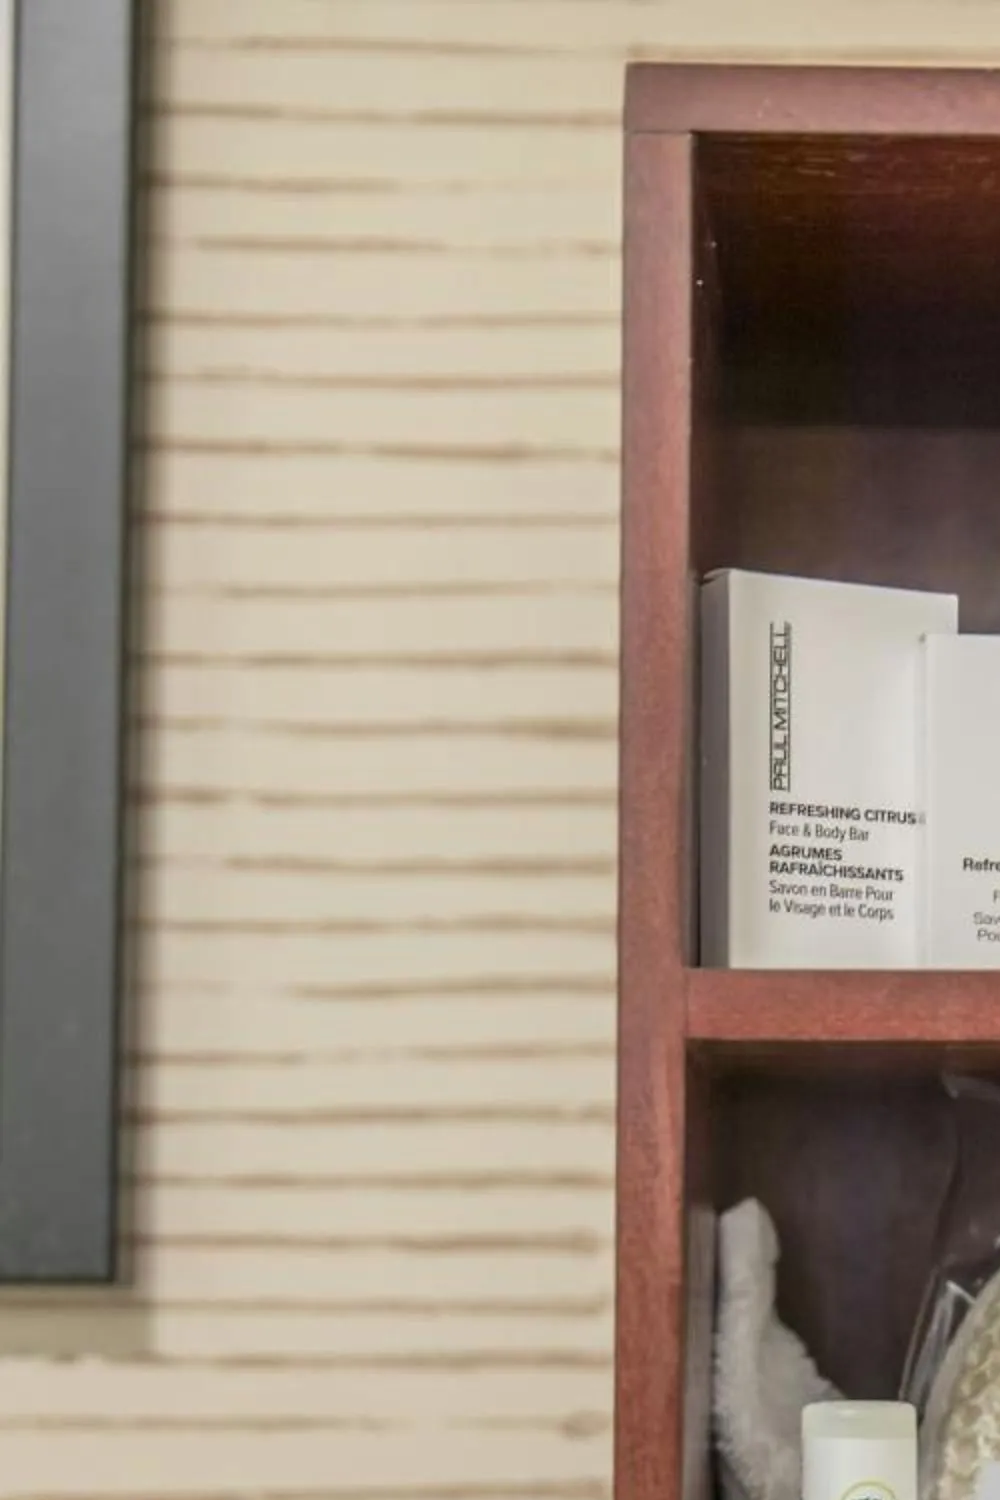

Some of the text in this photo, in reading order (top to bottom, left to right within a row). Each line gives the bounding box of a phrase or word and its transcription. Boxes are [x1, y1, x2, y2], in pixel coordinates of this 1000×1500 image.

[772, 622, 788, 791] PAUL MITCHELL
[769, 801, 917, 825] REFRESHING CITRUS
[769, 820, 870, 843] Face & Body Bar
[769, 844, 843, 861] AGRUMES
[769, 880, 894, 901] Savon en Barre Pour
[769, 898, 895, 922] le Visage et le Corps
